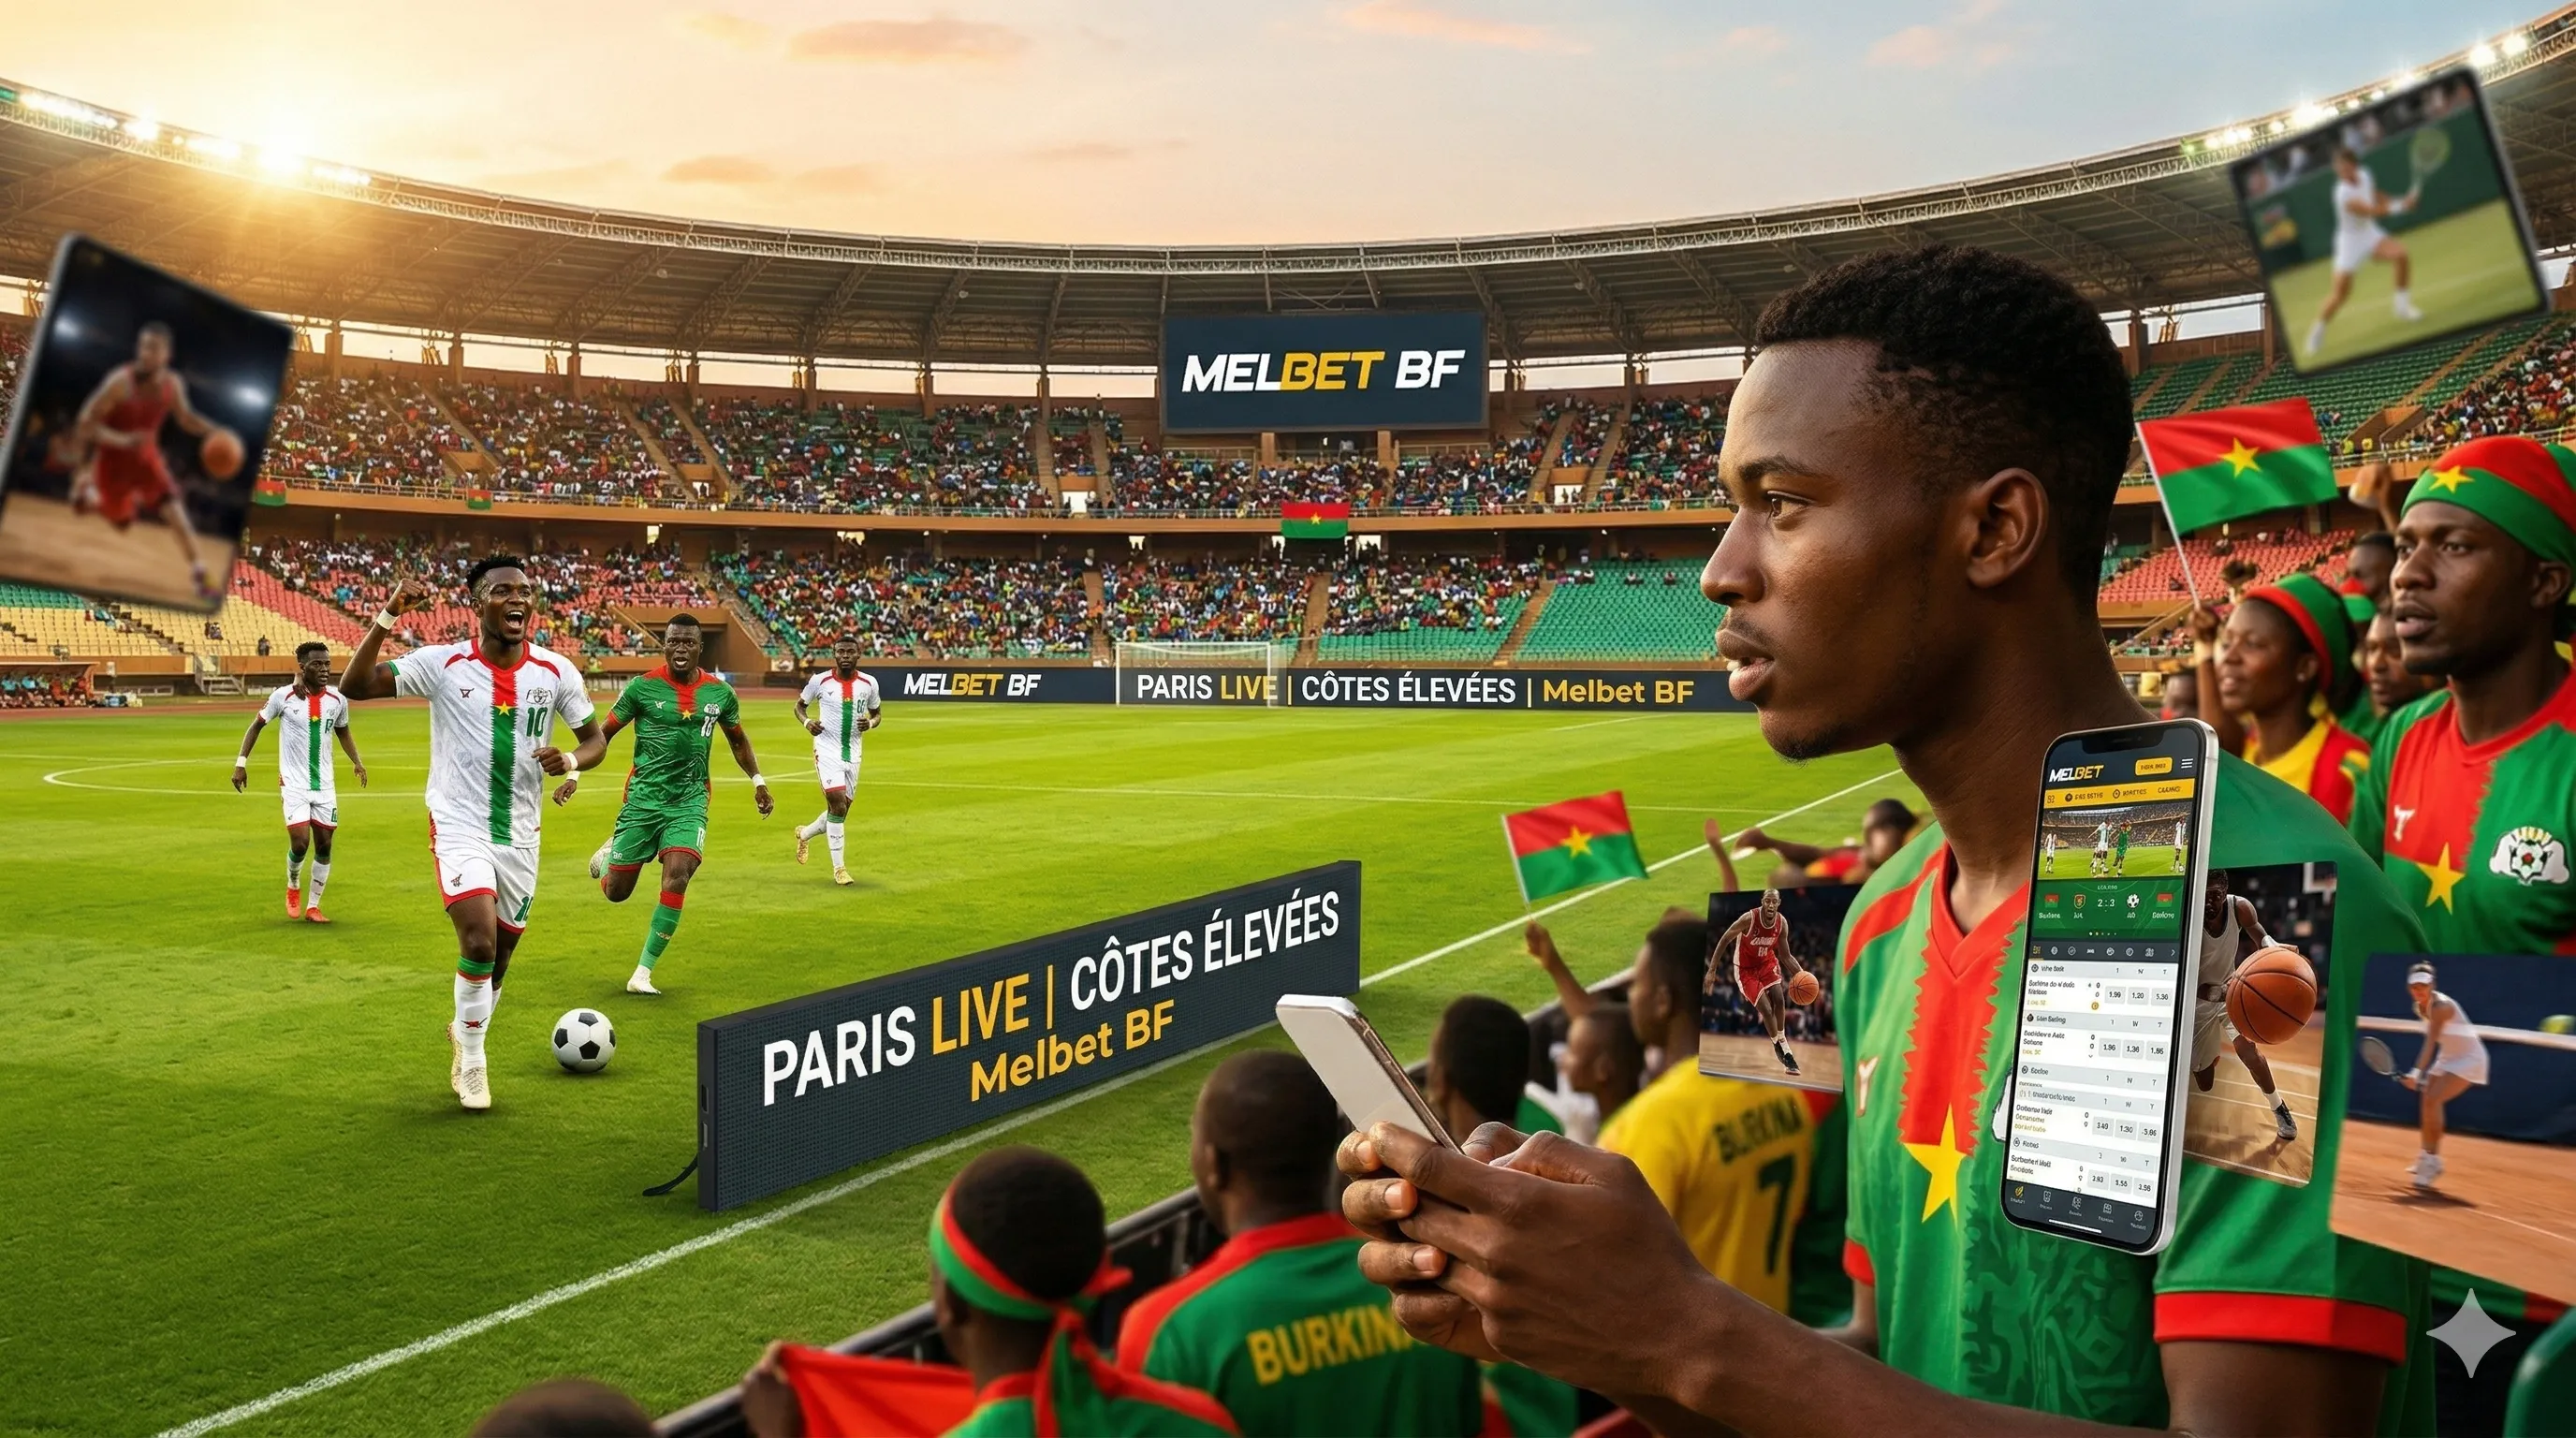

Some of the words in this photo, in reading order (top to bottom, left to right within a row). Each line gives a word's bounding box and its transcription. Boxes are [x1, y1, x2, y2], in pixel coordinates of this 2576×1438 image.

[1181, 351, 1385, 392] MELBET
[1395, 349, 1466, 389] BF
[903, 673, 1003, 697] MELBET
[1006, 673, 1042, 697] BF
[1137, 674, 1213, 700] PARIS
[1221, 675, 1278, 700] LIVE
[1302, 670, 1390, 703] CÔTES
[1398, 671, 1516, 703] ÉLEVÉES
[1544, 679, 1646, 704] Melbet
[1655, 681, 1694, 704] BF
[525, 706, 549, 738] 10
[2048, 764, 2105, 783] MELBET
[763, 1005, 915, 1108] PARIS
[932, 973, 1030, 1056] LIVE
[1071, 936, 1193, 1011] CÔTES
[1204, 888, 1339, 974] ÉLEVÉES
[970, 1021, 1114, 1103] Melbet
[1125, 999, 1176, 1049] BF
[1756, 1152, 1796, 1276] 7
[1246, 1304, 1412, 1386] BURKIN
